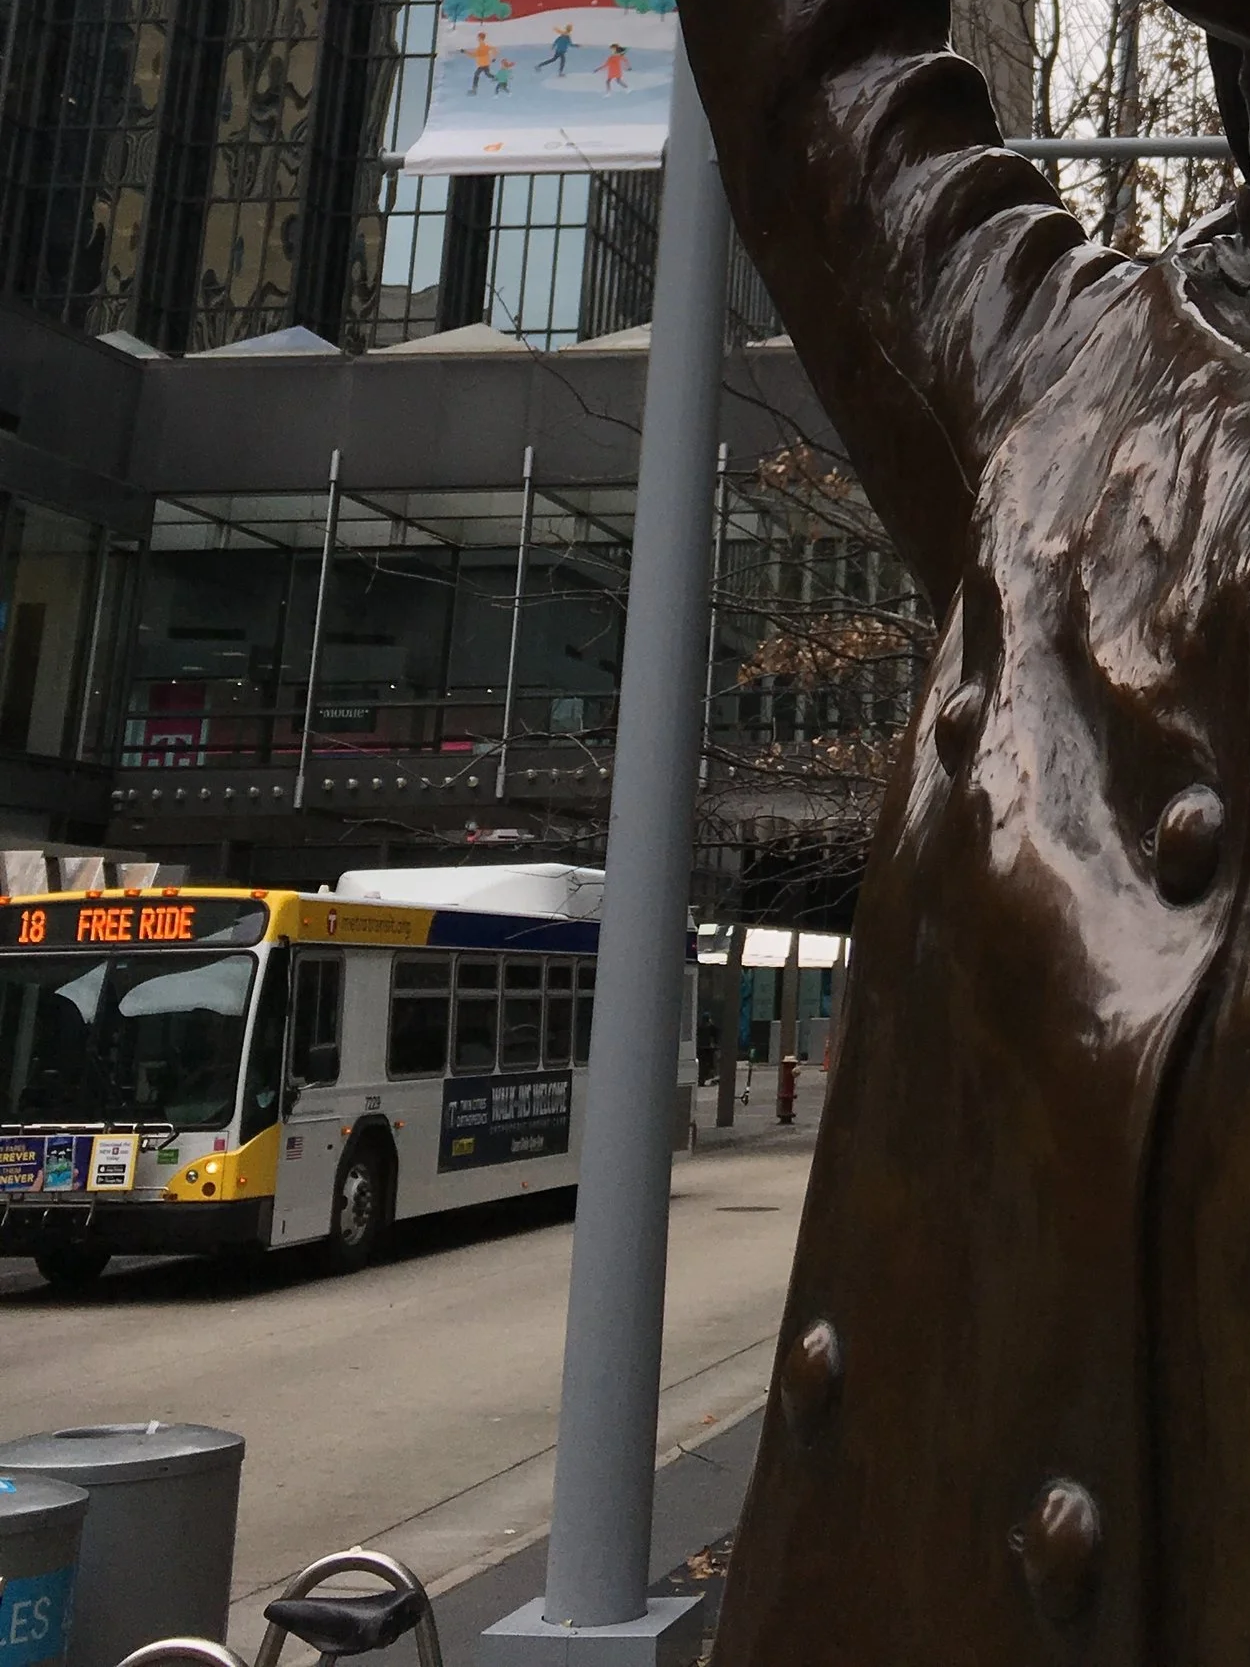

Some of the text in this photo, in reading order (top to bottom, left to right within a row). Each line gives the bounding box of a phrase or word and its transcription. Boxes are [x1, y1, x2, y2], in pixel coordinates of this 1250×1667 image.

[18, 905, 196, 943] 18 FREE RIDE
[0, 1595, 51, 1648] ES
